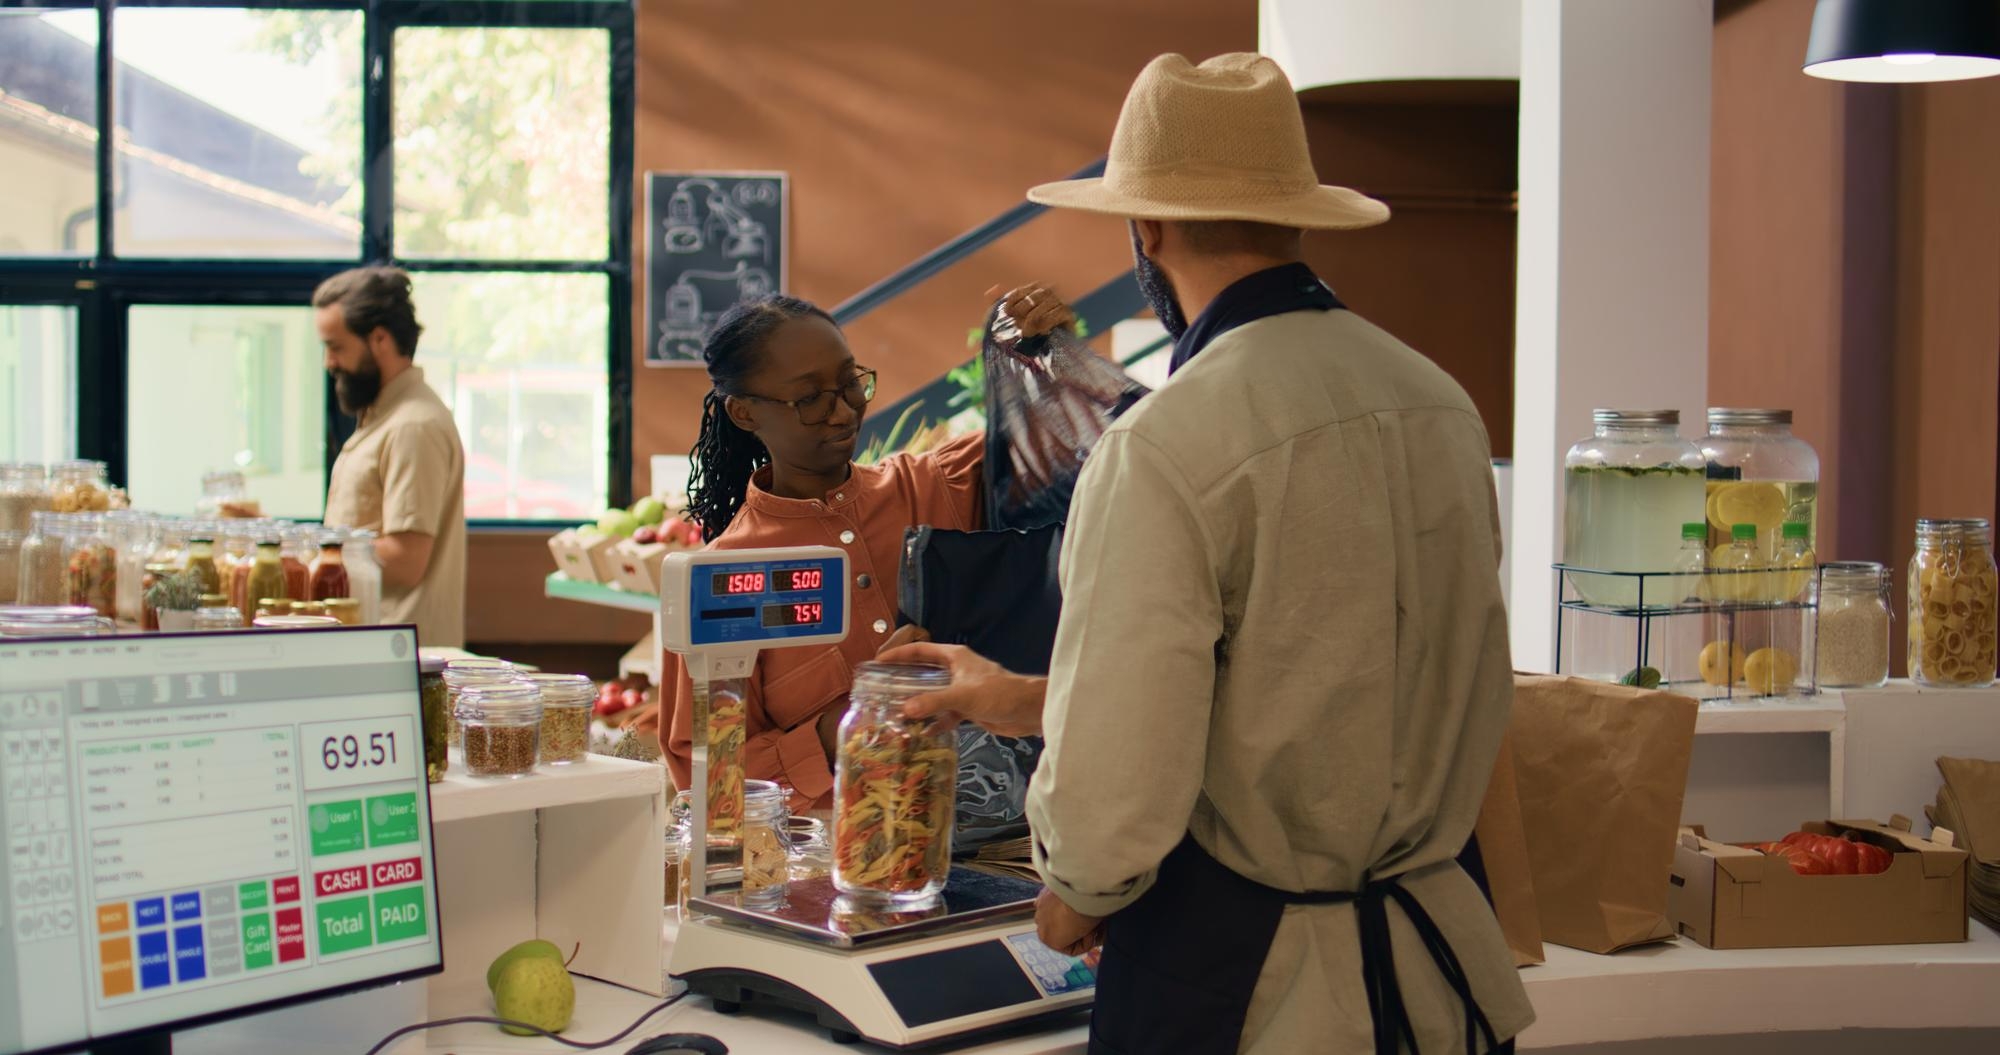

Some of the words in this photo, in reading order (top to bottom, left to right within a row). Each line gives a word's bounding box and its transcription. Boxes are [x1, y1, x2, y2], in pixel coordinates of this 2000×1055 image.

[728, 573, 765, 593] 1.508
[792, 571, 821, 590] 5.00
[794, 604, 821, 624] 7.54
[322, 731, 396, 770] 69.51
[330, 811, 351, 823] User
[353, 809, 358, 821] 1
[388, 805, 408, 816] User
[411, 802, 416, 813] 2
[322, 869, 362, 892] CASH
[376, 862, 415, 882] CARD
[139, 906, 159, 917] NEXT
[380, 903, 419, 927] PAID
[246, 924, 266, 939] Gift
[323, 912, 364, 937] Total
[244, 940, 271, 955] Card
[138, 954, 168, 966] DOUBLE
